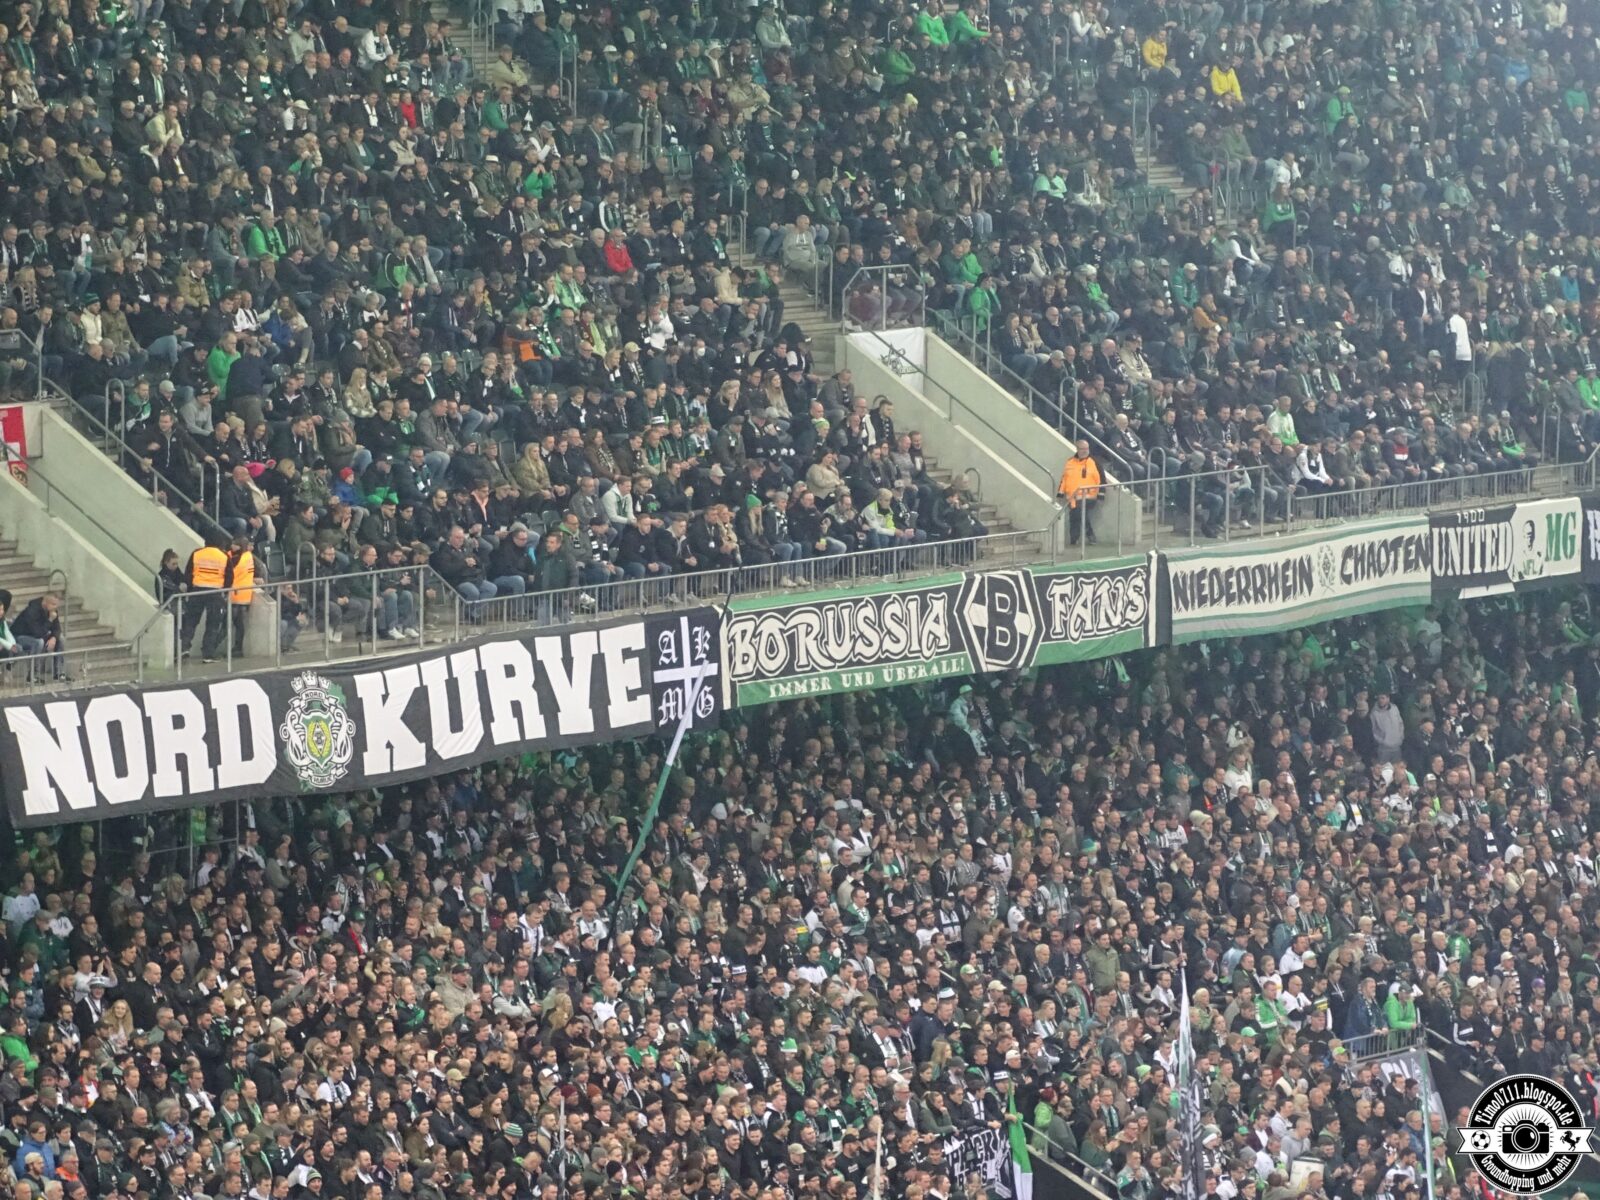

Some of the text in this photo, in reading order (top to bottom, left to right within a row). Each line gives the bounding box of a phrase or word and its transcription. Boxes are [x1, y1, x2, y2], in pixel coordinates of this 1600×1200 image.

[1431, 521, 1514, 577] UNITED
[1544, 511, 1577, 562] MG
[1456, 508, 1486, 524] 1900
[1171, 534, 1431, 613] NIEDERRHEIN CHAOTEN
[728, 591, 950, 678] BORUSSIA
[1047, 568, 1148, 643] FANS
[769, 657, 966, 699] IMMER UND ÜBERALL!
[4, 621, 653, 816] NORD KURVE
